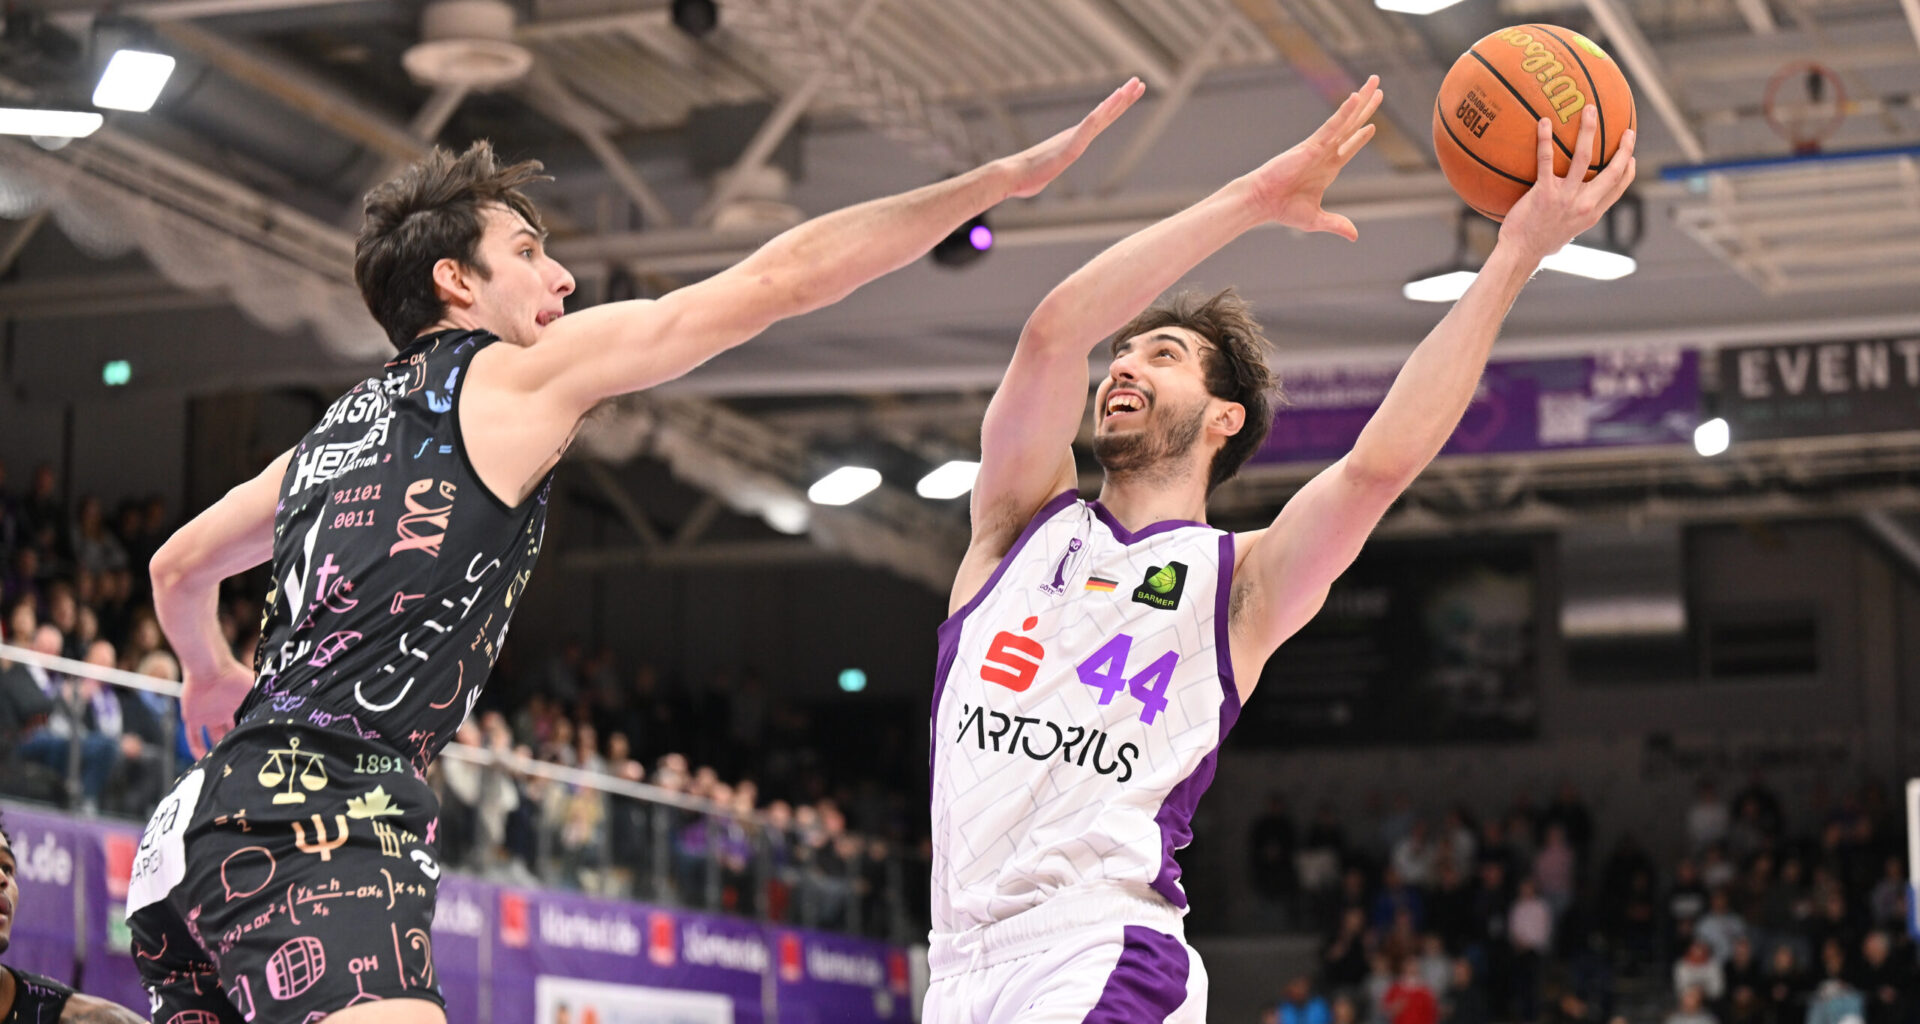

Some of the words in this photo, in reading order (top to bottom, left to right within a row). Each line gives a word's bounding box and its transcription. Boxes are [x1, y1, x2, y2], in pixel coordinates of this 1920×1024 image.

[1498, 28, 1586, 125] Wilson
[1456, 99, 1490, 139] FIBA
[1467, 90, 1497, 122] APPROVED
[1137, 591, 1175, 608] BARMER
[1075, 632, 1180, 726] 44
[353, 754, 404, 775] 1891
[348, 954, 379, 975] OH
